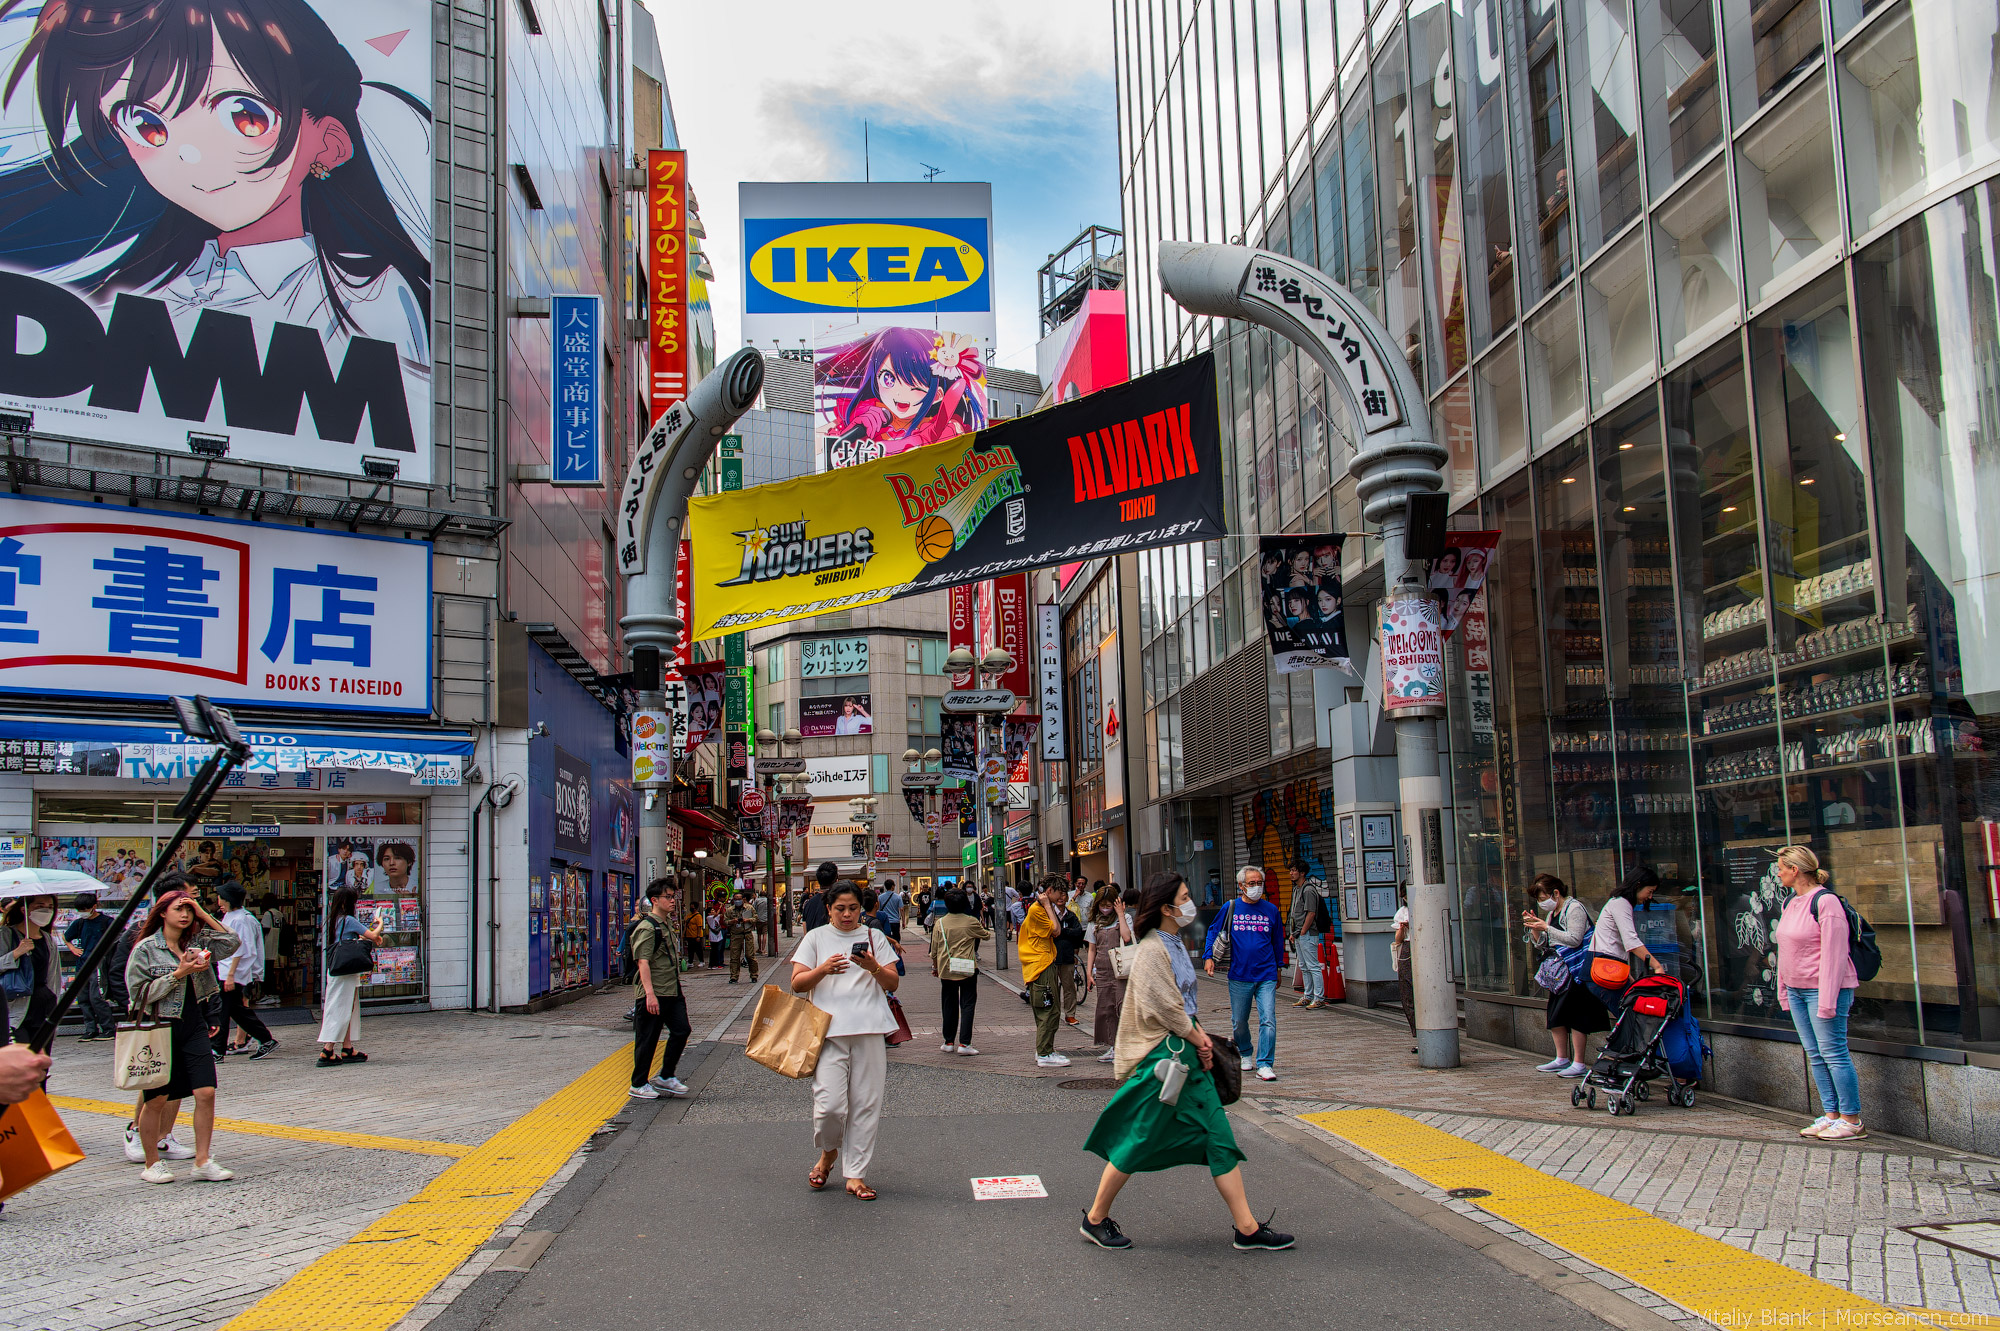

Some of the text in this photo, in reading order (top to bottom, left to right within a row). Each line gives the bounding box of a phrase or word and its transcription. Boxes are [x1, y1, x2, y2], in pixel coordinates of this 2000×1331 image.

[655, 161, 680, 354] クスリのことなら
[771, 247, 970, 283] IKEA
[1255, 267, 1389, 417] 渋谷センター街
[0, 270, 416, 453] DMM
[563, 308, 590, 472] 大盛堂商事ビル
[1067, 403, 1200, 503] ALVARK
[622, 409, 682, 569] 渋谷センター街
[884, 446, 1019, 528] Basketball
[955, 468, 1023, 551] STREET
[1119, 494, 1156, 523] TOKYO
[769, 520, 805, 544] SUN
[716, 526, 878, 587] ROCKERS
[814, 567, 860, 586] SHIBUYA
[953, 595, 966, 630] ECHO
[998, 589, 1018, 673] BIG ECHO
[1274, 630, 1293, 642] IVE
[1387, 631, 1438, 655] WELCOME
[819, 640, 868, 657] れいわ
[1387, 653, 1441, 666] TO SHIBUYA
[803, 658, 868, 675] クリニック
[265, 673, 402, 697] BOOKS TAISEIDO
[947, 695, 1011, 704] 渋谷センター街
[1043, 656, 1059, 754] 山下本気うどん
[165, 731, 298, 746] TAEIDO
[636, 721, 655, 735] Enjoy
[691, 735, 702, 743] IVE
[634, 741, 668, 751] Welcome
[730, 742, 745, 768] HUB
[218, 771, 347, 789] 盛堂書店
[556, 781, 577, 820] BOSS
[744, 798, 762, 808] 消火栓
[559, 820, 574, 838] COFFEE
